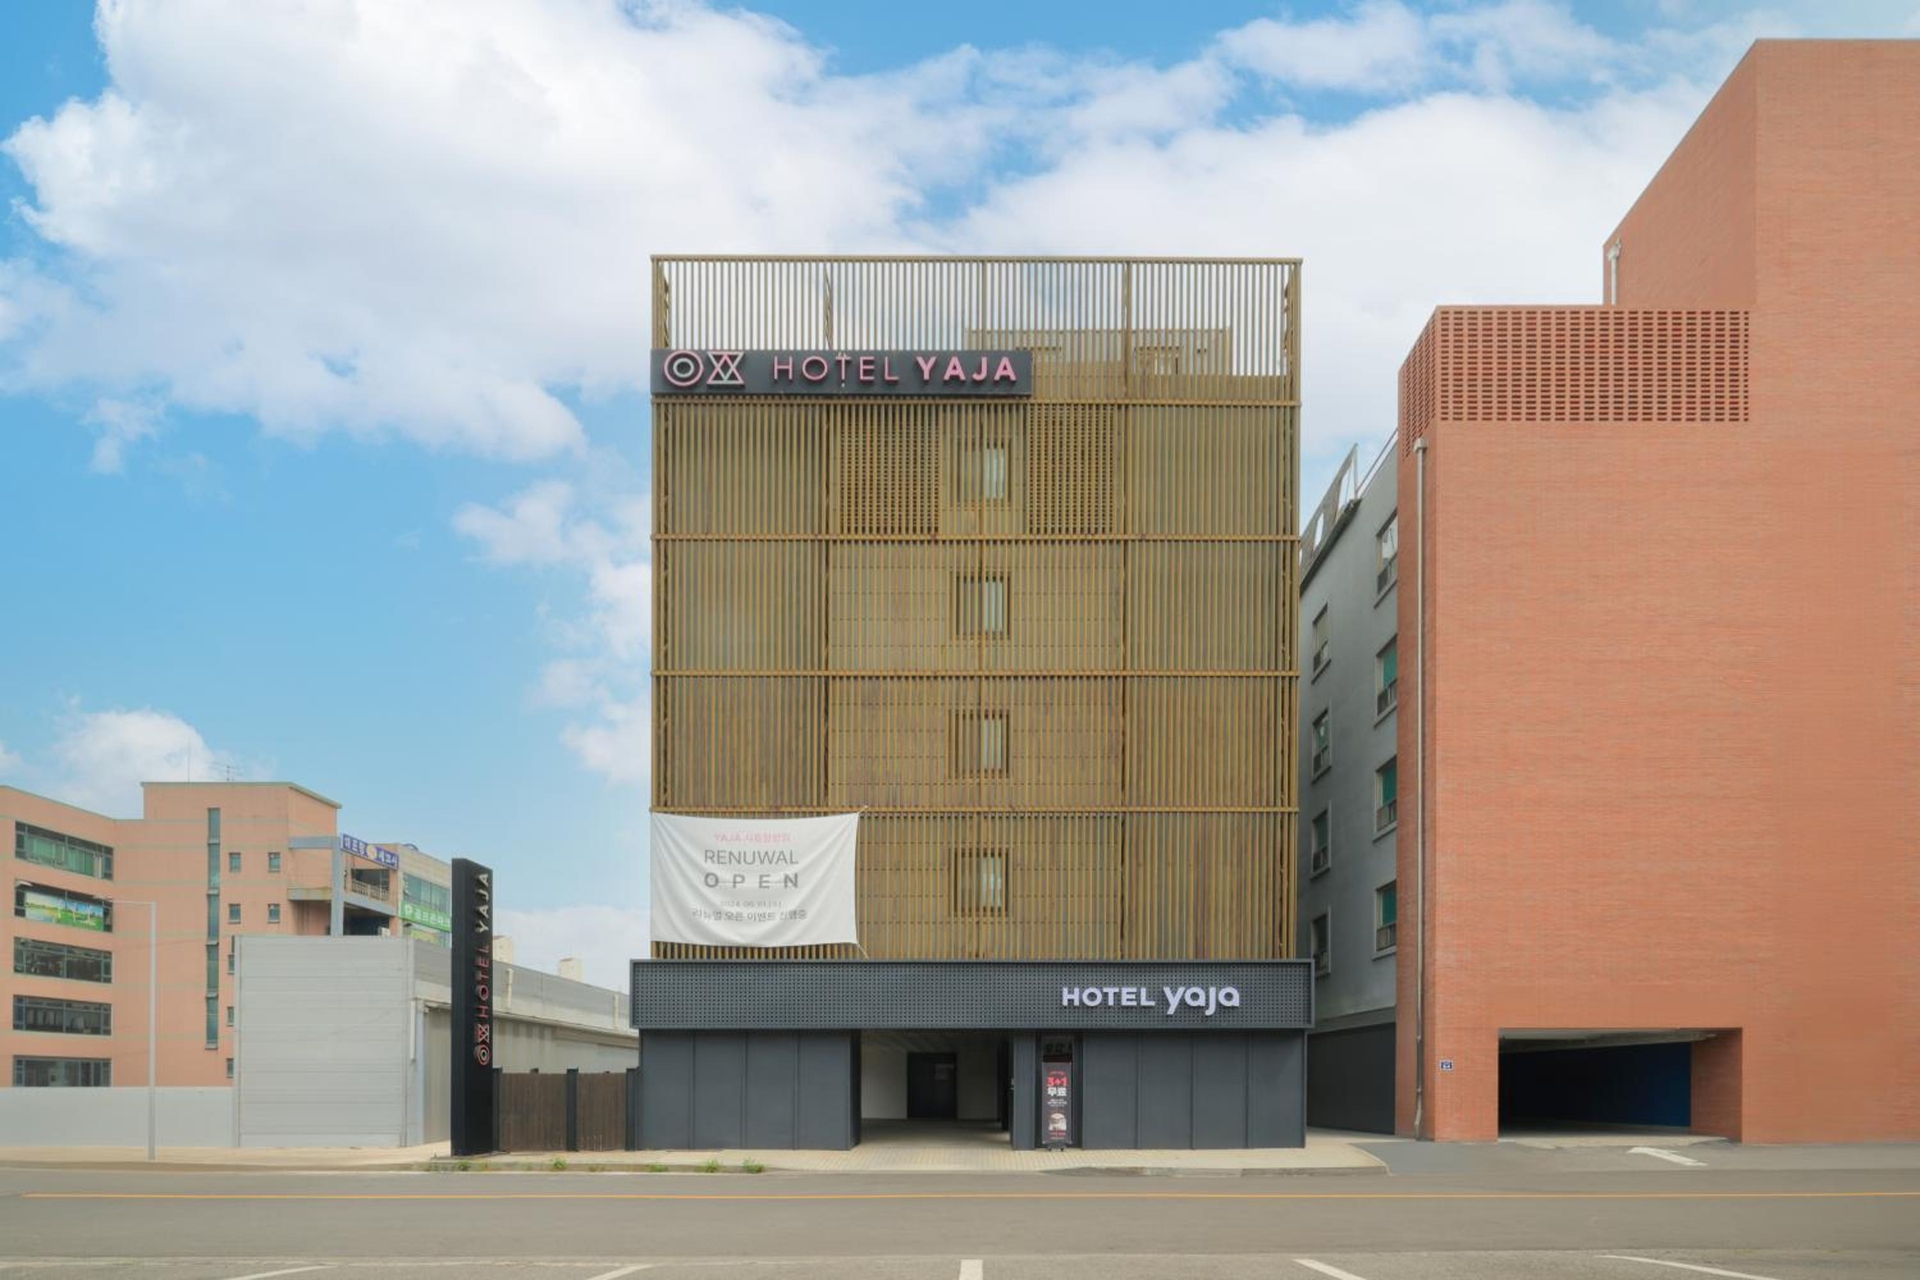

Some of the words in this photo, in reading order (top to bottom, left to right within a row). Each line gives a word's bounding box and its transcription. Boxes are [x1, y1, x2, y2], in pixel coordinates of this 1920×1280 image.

[772, 355, 899, 382] HOTEL
[915, 355, 1017, 382] YAJA
[703, 849, 800, 866] RENUWAL
[703, 871, 799, 889] OPEN
[474, 872, 490, 934] YAJA
[474, 945, 490, 1019] HOTEL
[1062, 986, 1156, 1008] HOTEL
[1162, 986, 1241, 1017] yaja
